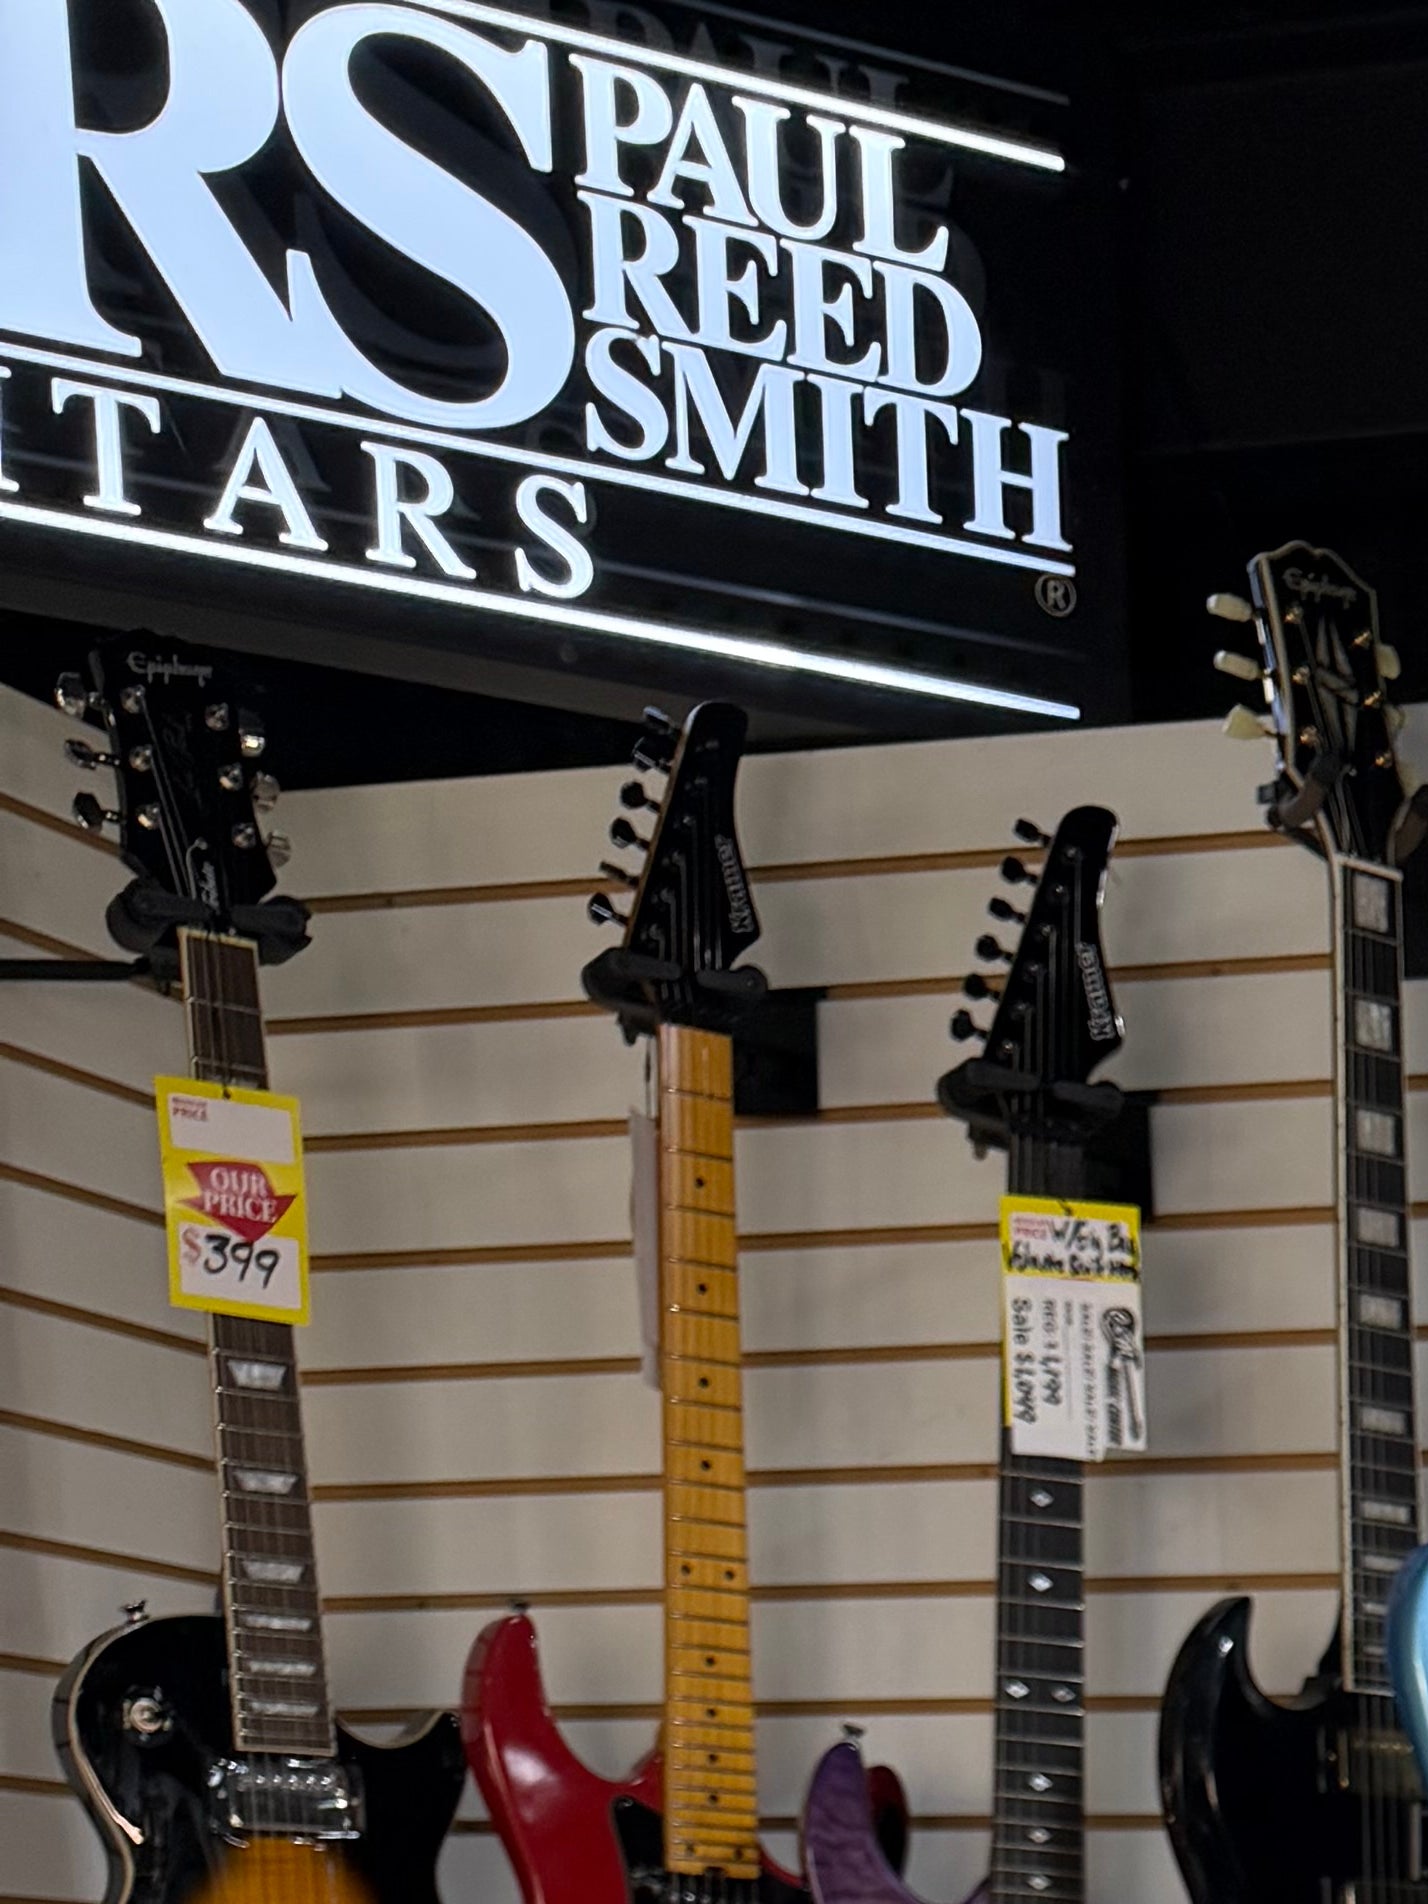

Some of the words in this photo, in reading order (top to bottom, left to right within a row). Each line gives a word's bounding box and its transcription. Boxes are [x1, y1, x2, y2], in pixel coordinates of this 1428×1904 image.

[568, 53, 950, 272] PAUL
[577, 190, 983, 398] REED
[0, 368, 596, 599] TARS
[586, 328, 1073, 553] SMITH
[201, 1191, 279, 1224] PRICE
[210, 1166, 268, 1198] OUR
[182, 1226, 280, 1290] $399
[1011, 1297, 1035, 1346] Sale
